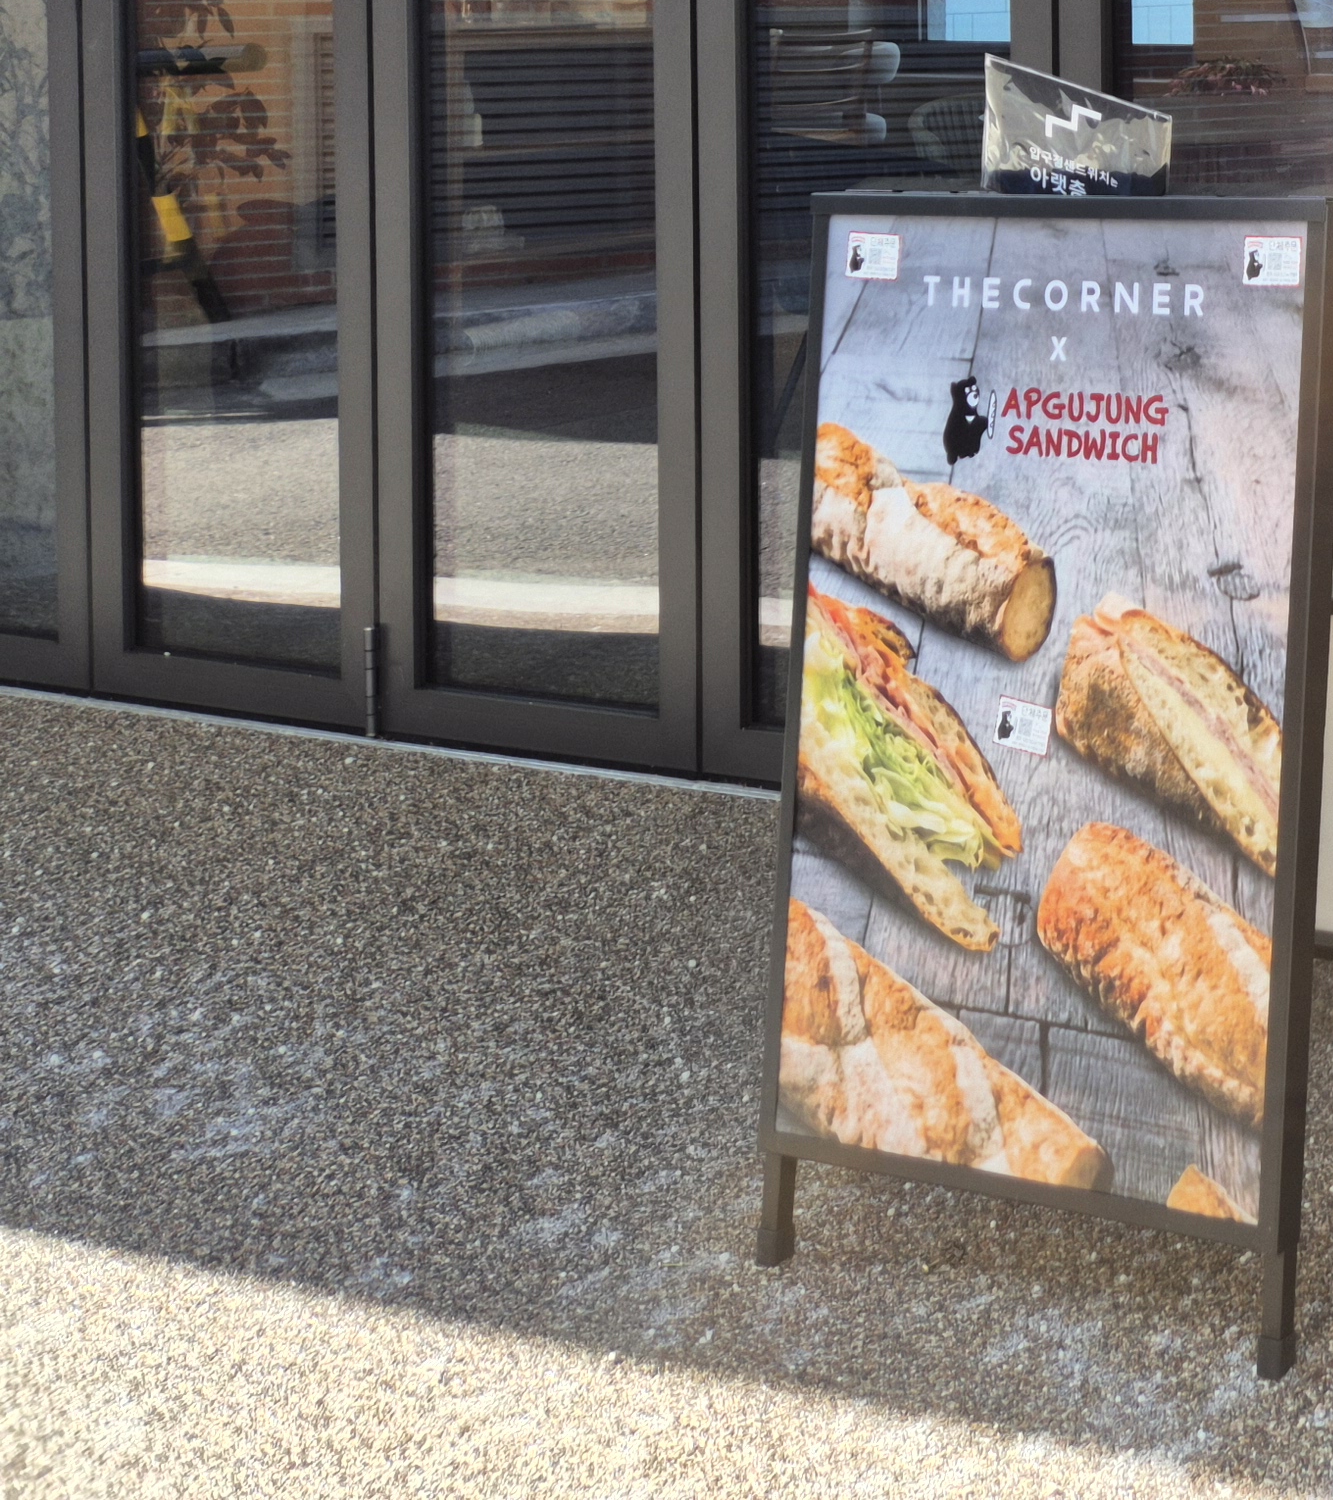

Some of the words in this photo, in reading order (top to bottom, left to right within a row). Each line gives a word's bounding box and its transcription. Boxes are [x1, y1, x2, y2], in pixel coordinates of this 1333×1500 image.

[1030, 167, 1087, 196] 아랫층
[1001, 387, 1169, 427] APGUJUNG
[1006, 425, 1159, 464] SANDWICH
